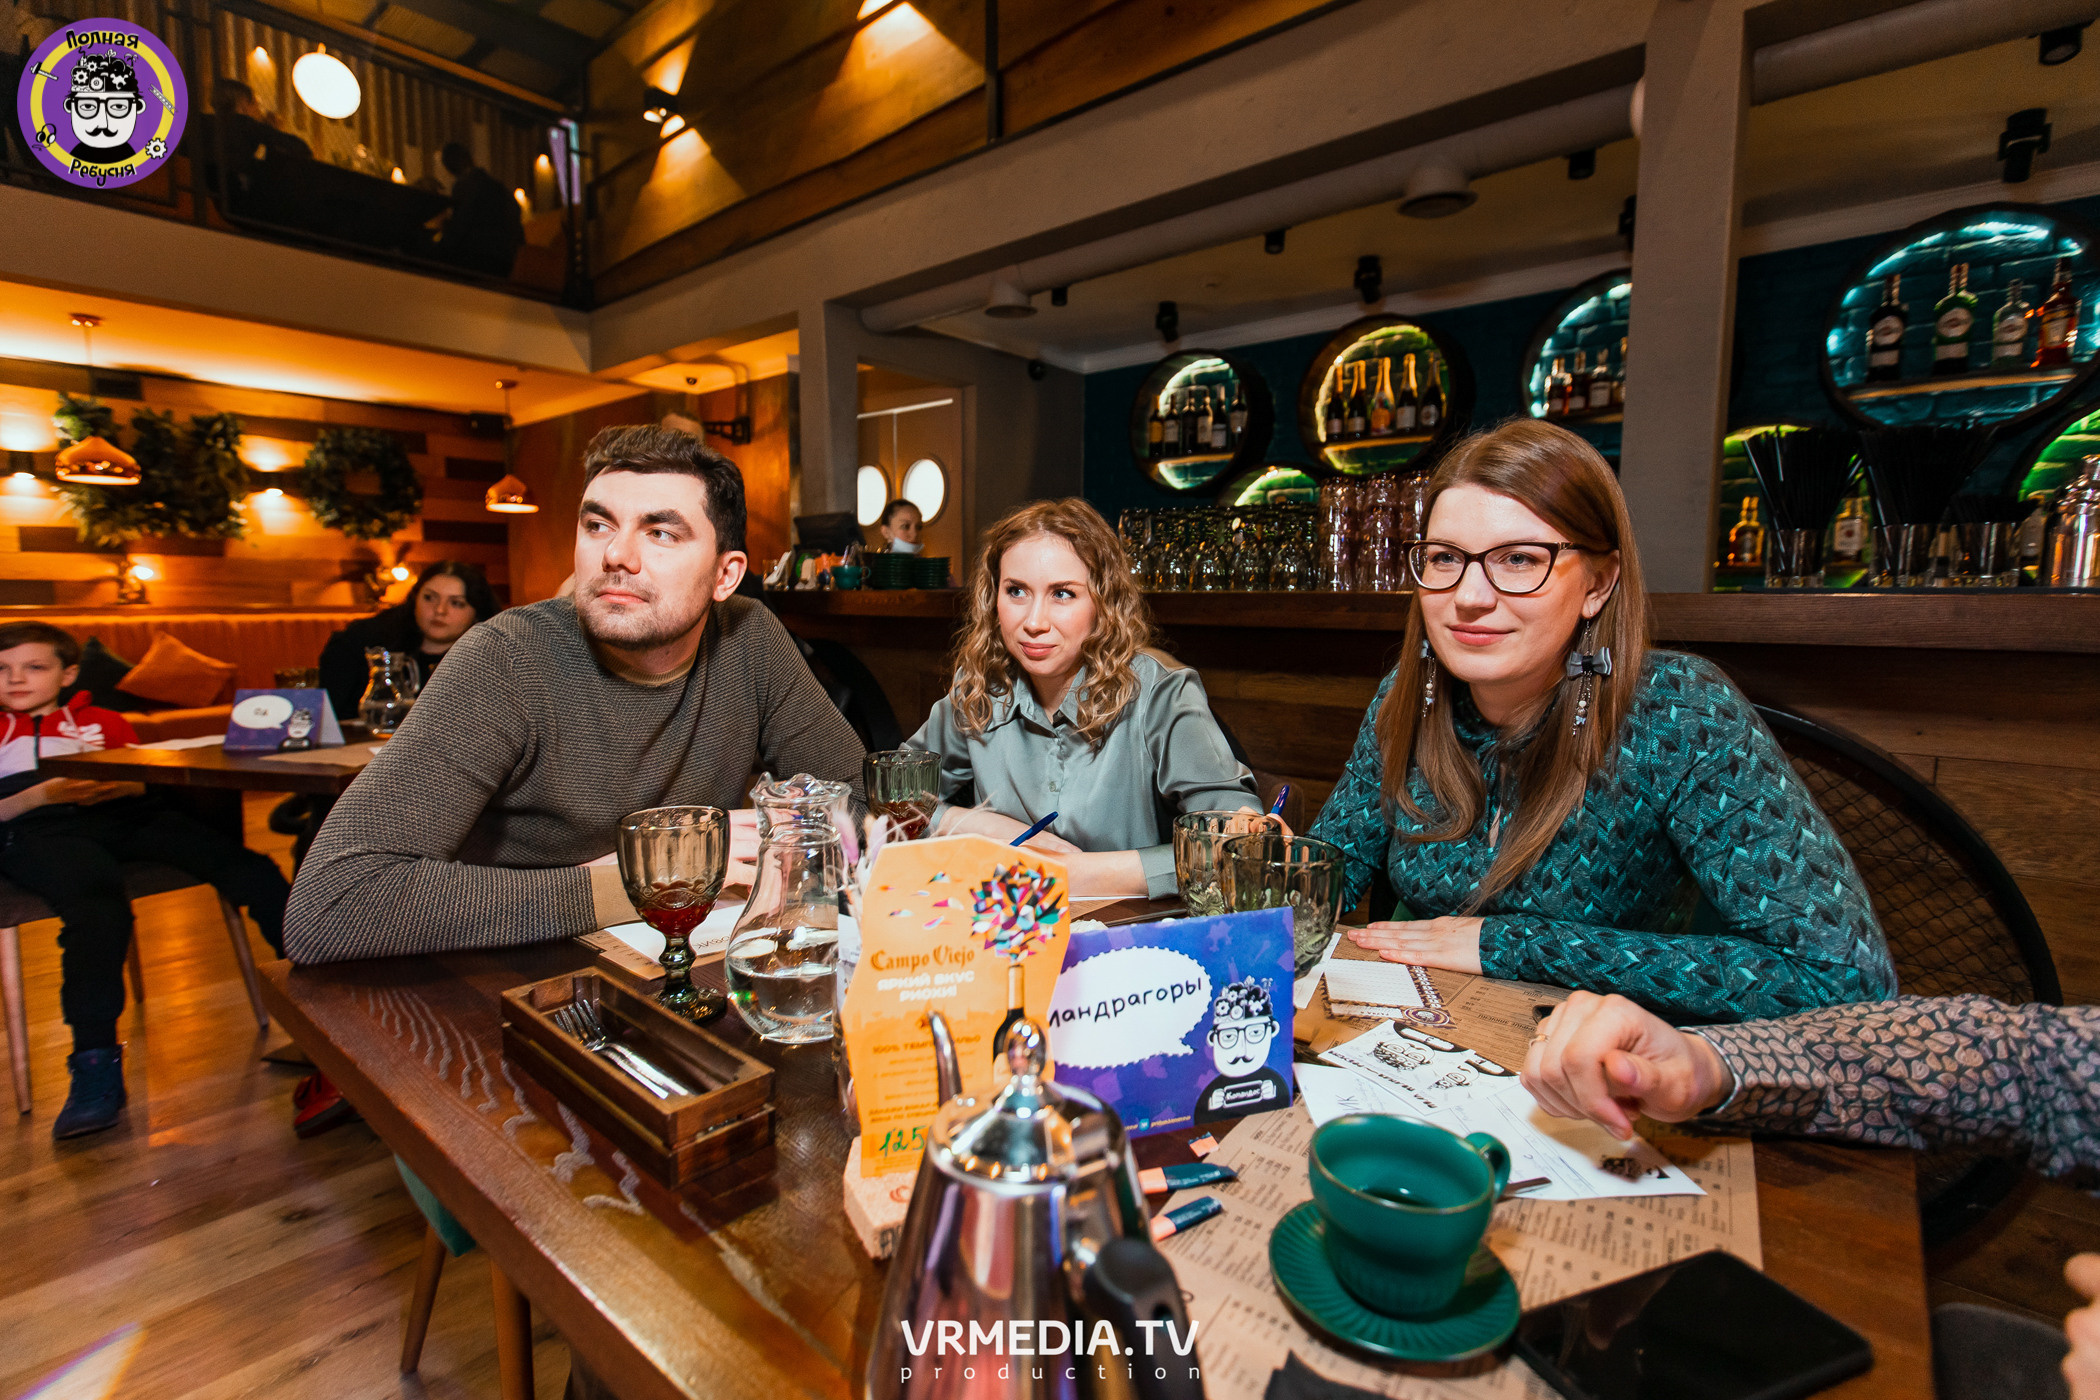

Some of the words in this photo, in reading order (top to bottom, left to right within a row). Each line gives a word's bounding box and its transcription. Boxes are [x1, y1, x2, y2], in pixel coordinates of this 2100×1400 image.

[870, 949, 931, 974] Campo
[932, 944, 975, 969] Viejo
[877, 972, 931, 991] ЯРКИЙ
[934, 970, 975, 986] ВКУС
[878, 1125, 927, 1159] 125
